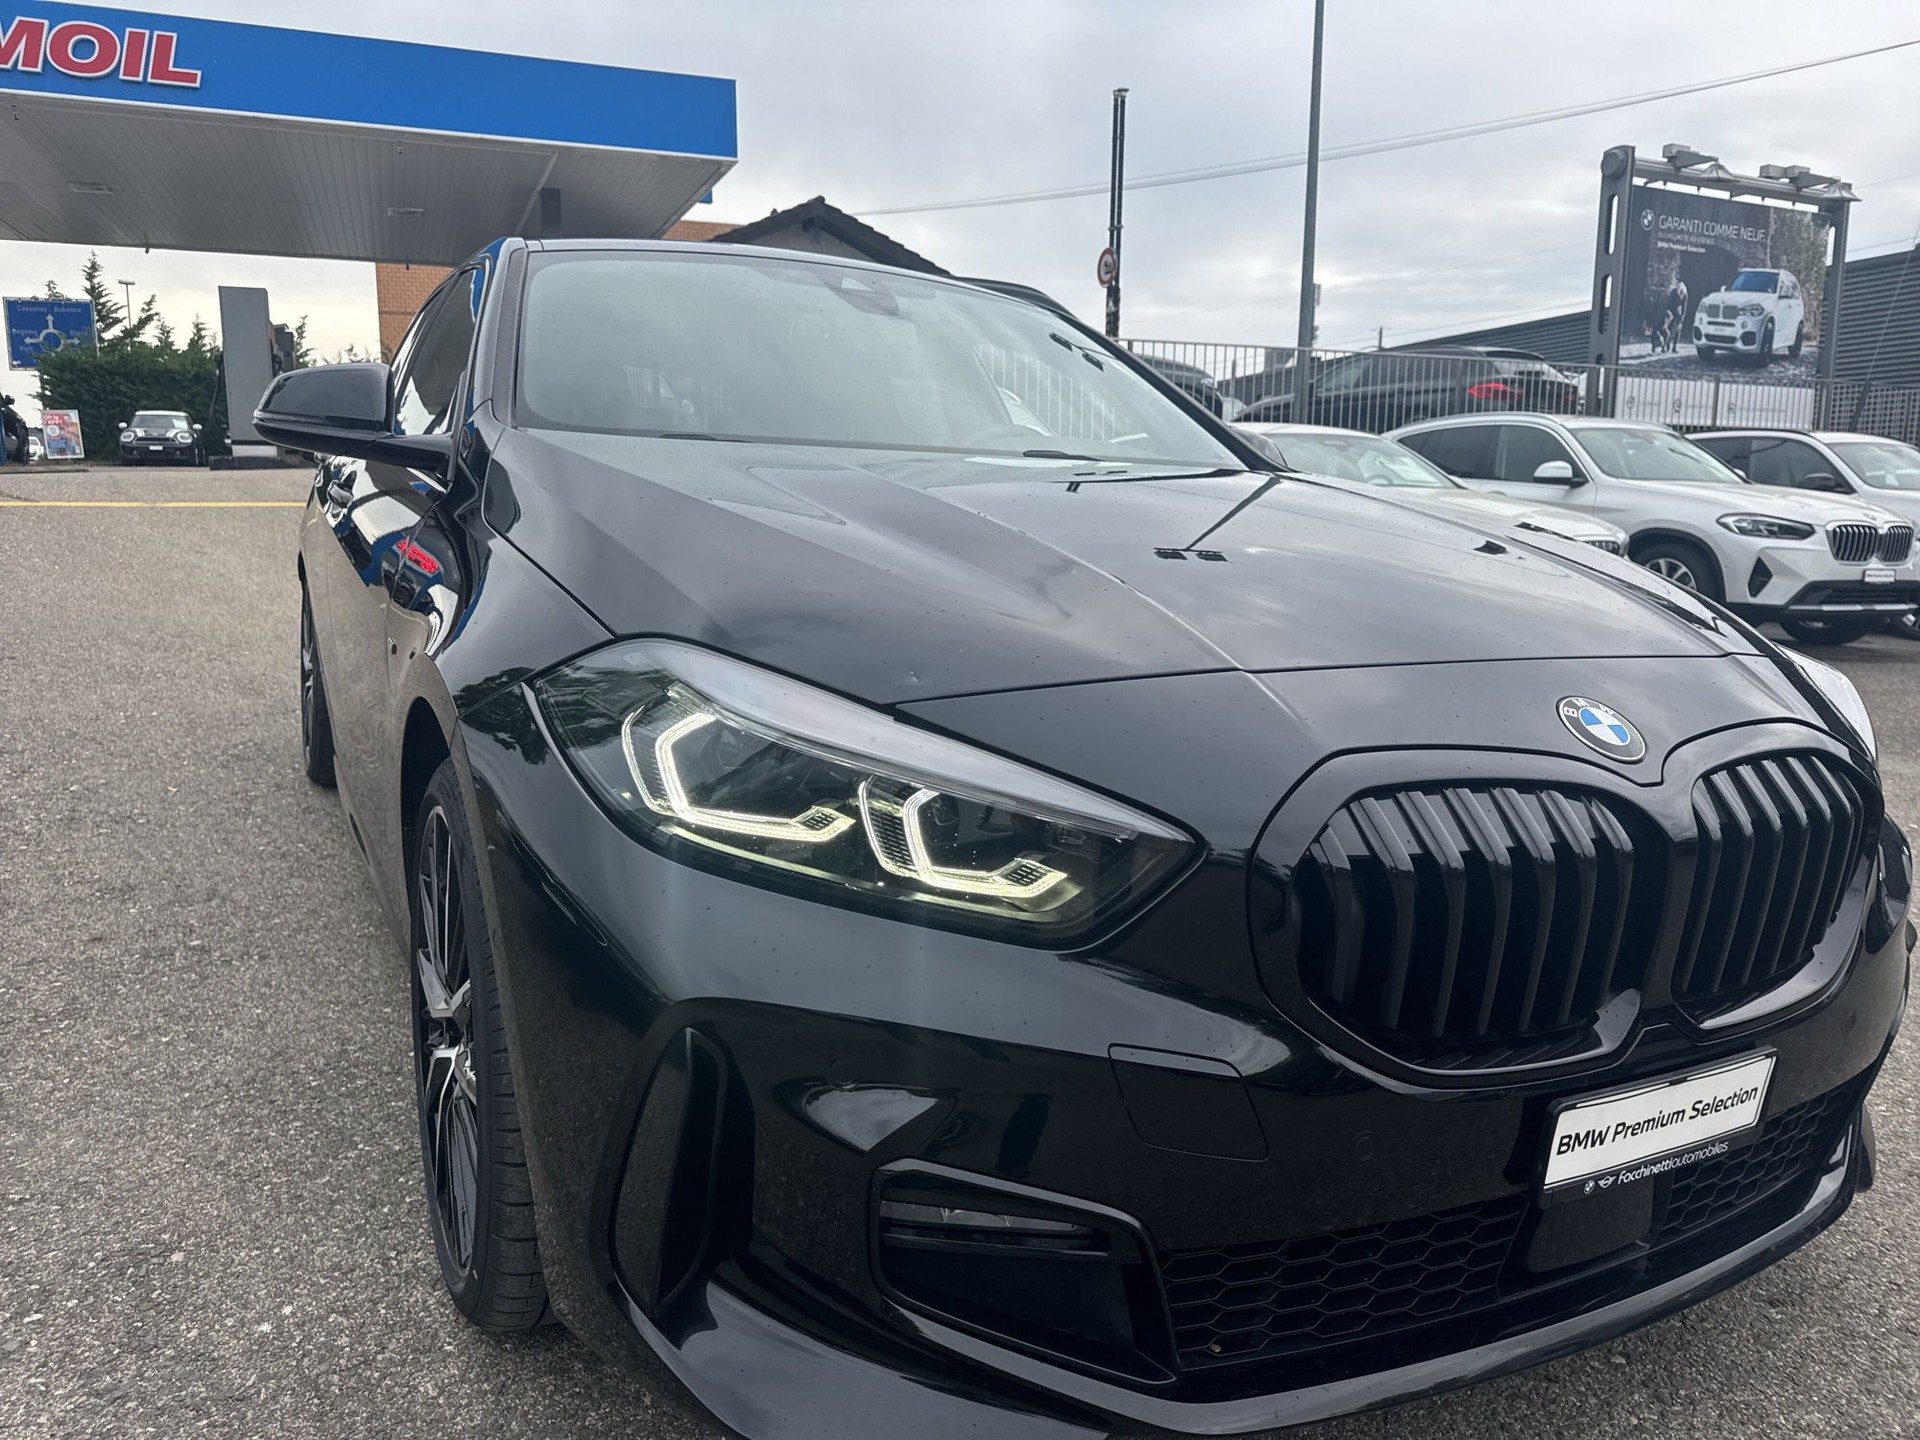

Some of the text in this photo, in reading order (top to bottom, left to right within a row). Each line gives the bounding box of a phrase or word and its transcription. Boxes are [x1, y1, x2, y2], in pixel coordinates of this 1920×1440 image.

[1659, 215, 1702, 233] GARANTI
[1703, 221, 1739, 239] COMME
[1740, 226, 1766, 242] NEUF.
[1556, 1086, 1758, 1156] BMW Premium Selection
